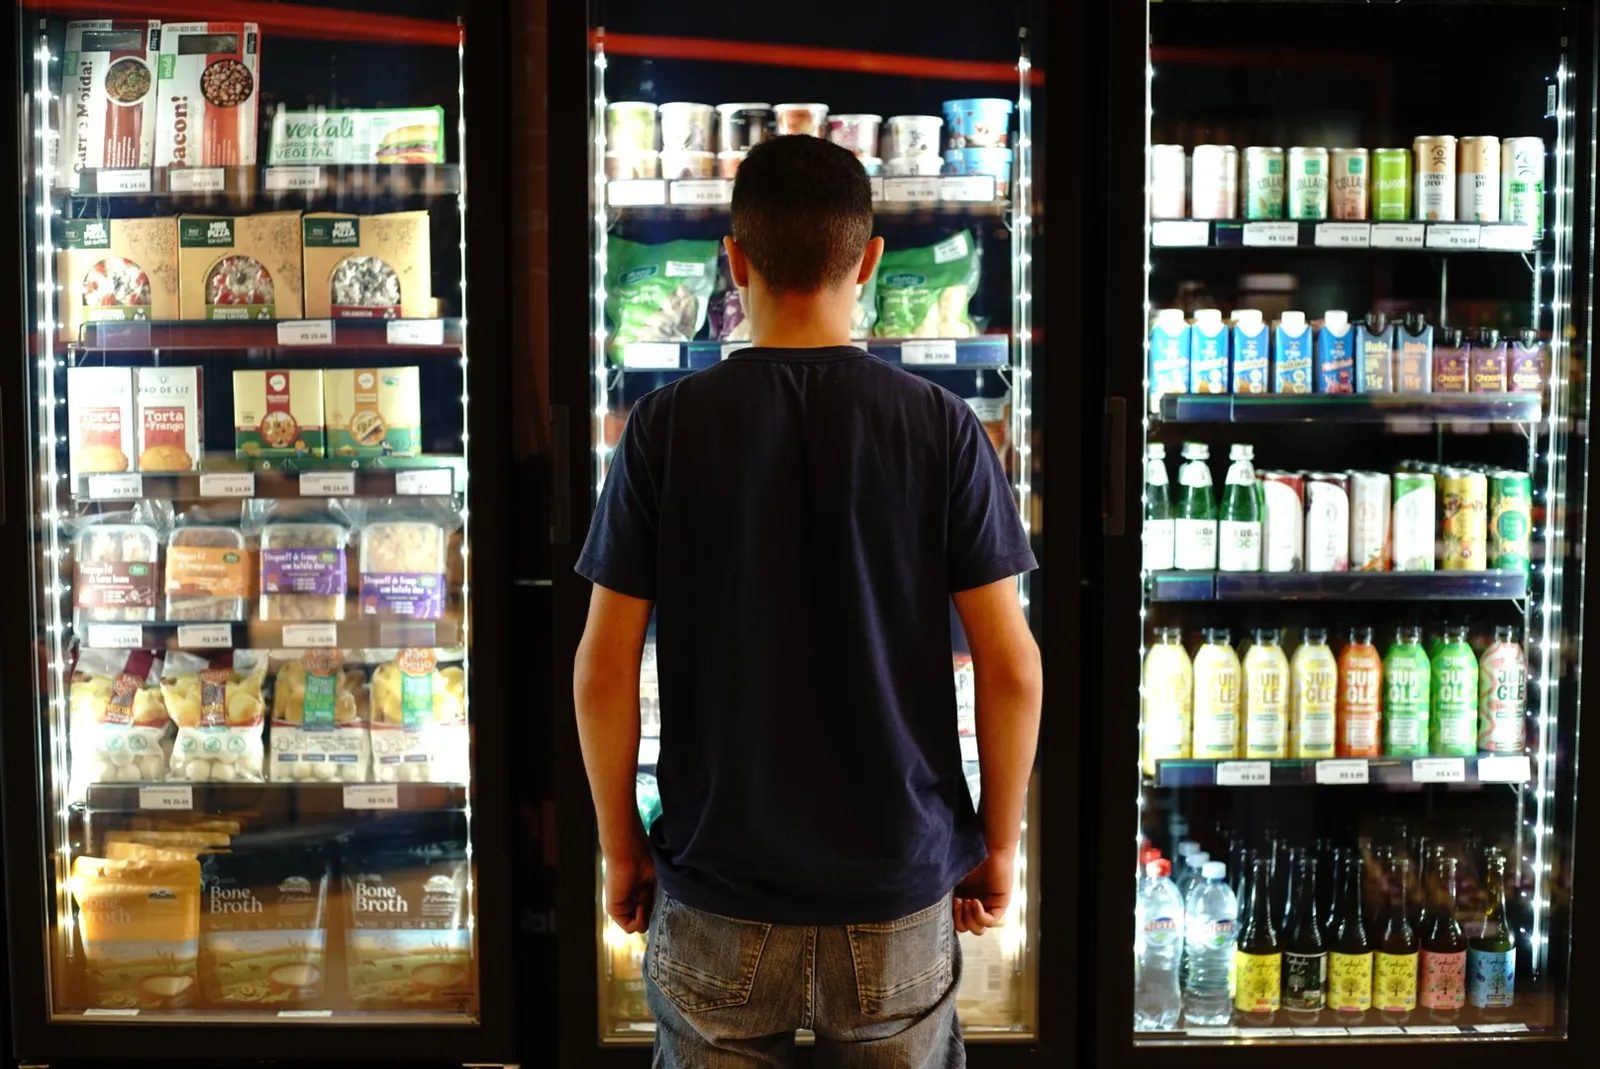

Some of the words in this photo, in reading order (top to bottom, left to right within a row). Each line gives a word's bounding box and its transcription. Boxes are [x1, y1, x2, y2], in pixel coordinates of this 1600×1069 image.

[207, 228, 230, 238] PIZZA
[332, 228, 356, 238] PIZZA
[160, 386, 171, 394] DE
[145, 410, 183, 422] Torta
[1346, 670, 1378, 687] JUN
[1346, 686, 1378, 704] GLE
[210, 886, 251, 901] Bone
[355, 882, 396, 897] Bone
[210, 898, 264, 915] Broth
[355, 895, 408, 912] Broth
